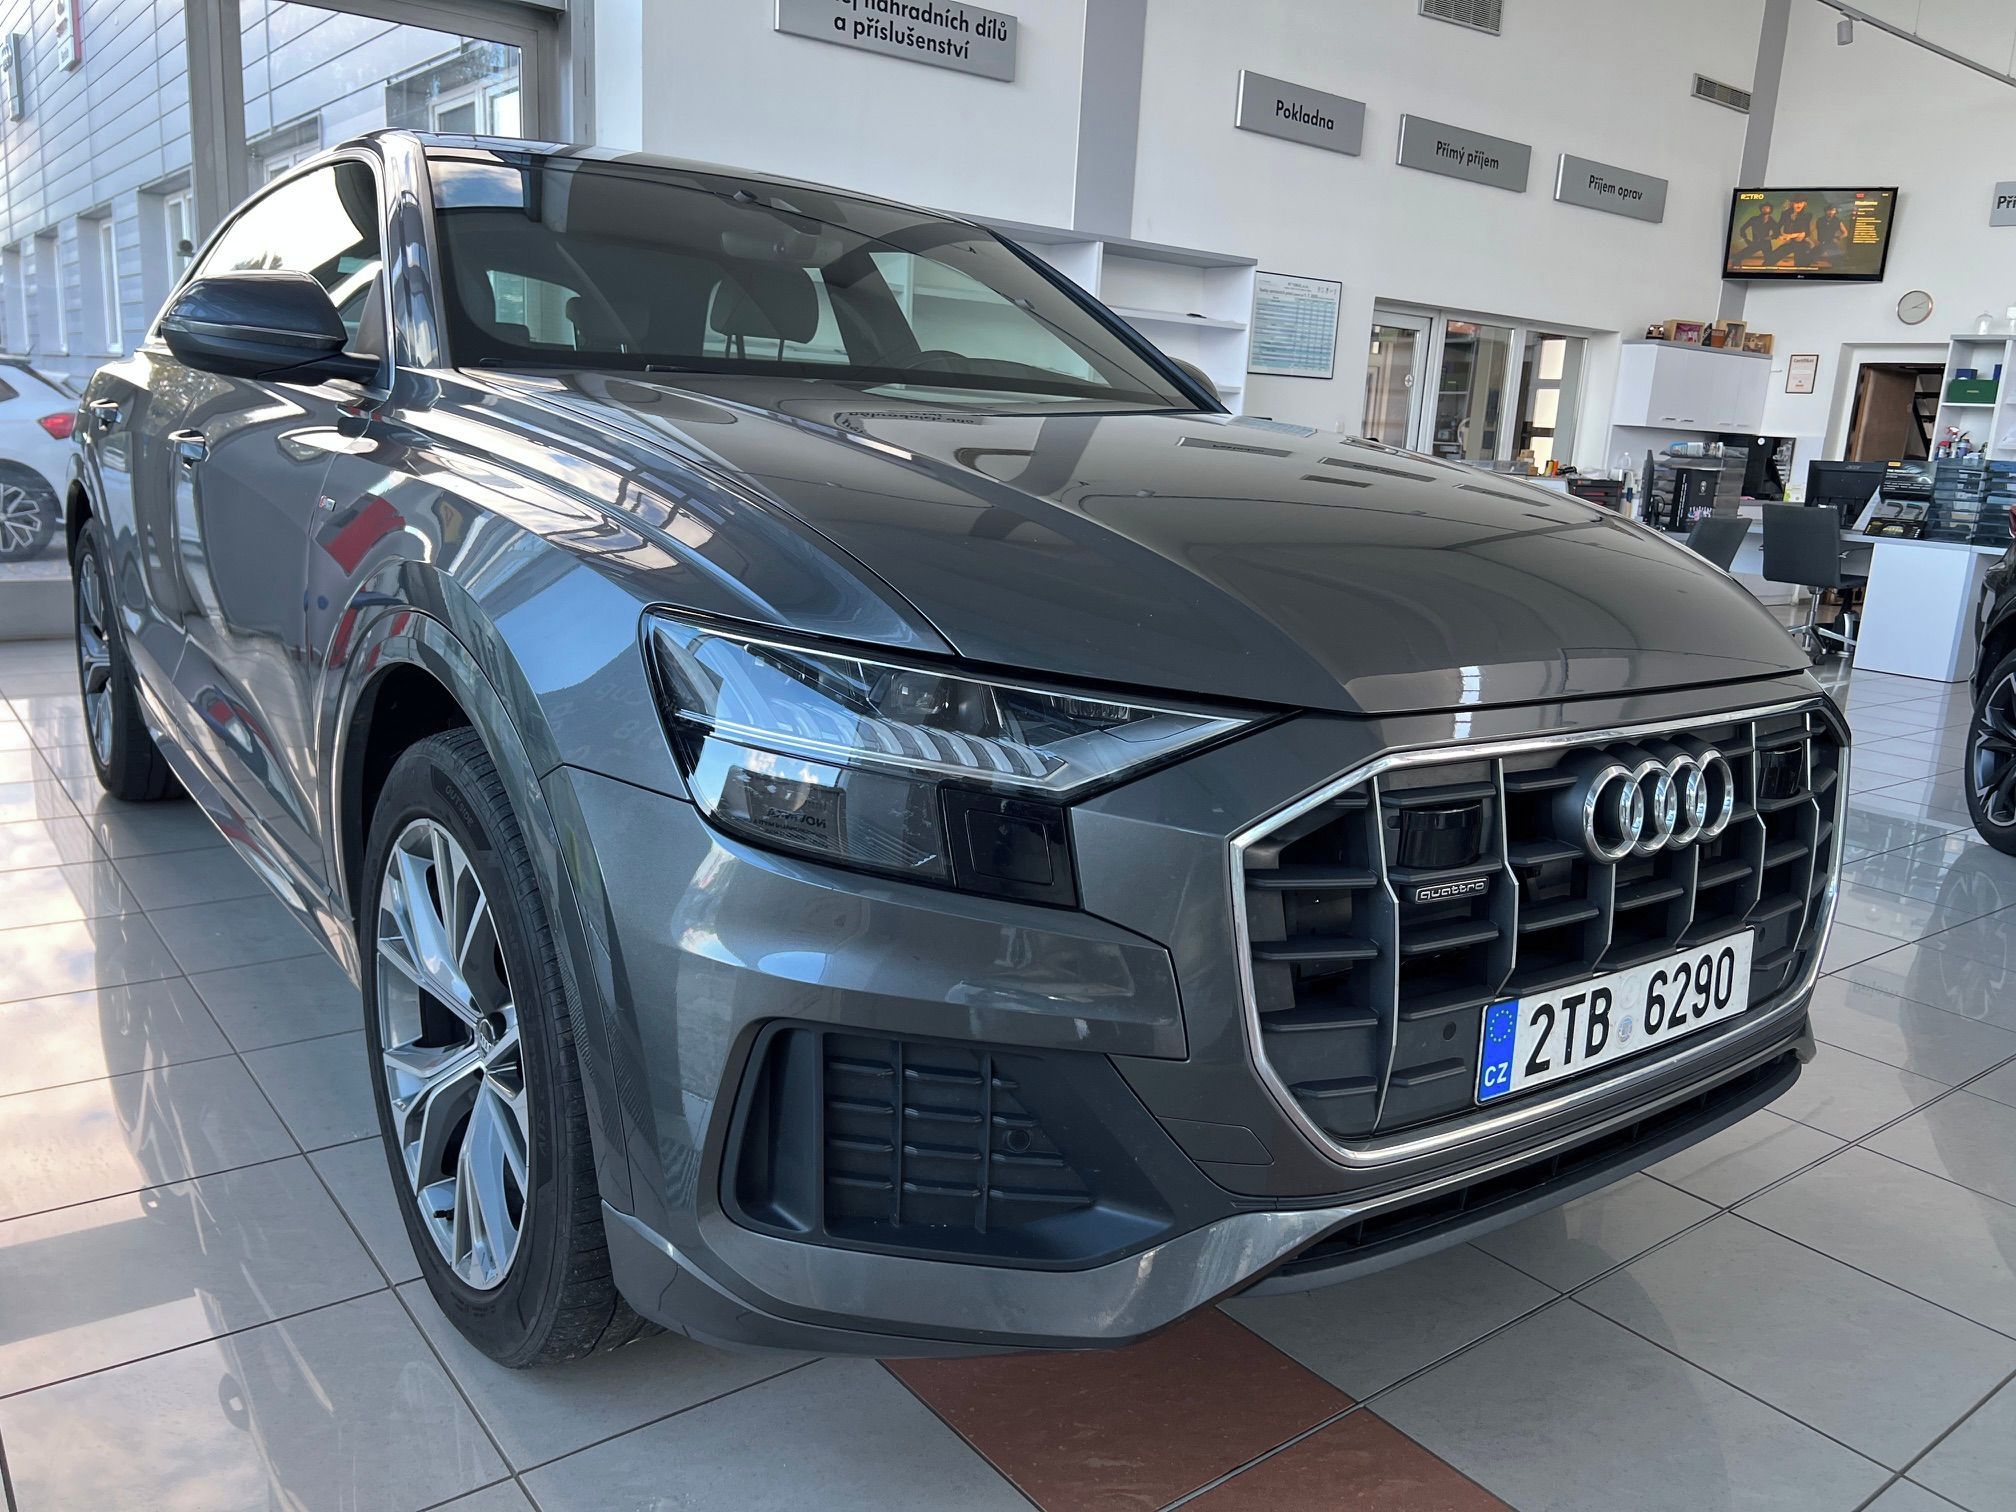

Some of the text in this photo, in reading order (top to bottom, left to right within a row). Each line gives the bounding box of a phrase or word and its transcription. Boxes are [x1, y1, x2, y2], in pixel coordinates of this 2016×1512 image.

[834, 16, 970, 59] a příslušenství
[975, 16, 1008, 41] dílů
[1275, 99, 1334, 130] Pokladna
[1435, 140, 1499, 170] Přímý příjem
[1588, 175, 1643, 201] Příjem oprav
[1420, 881, 1485, 900] quattro
[1524, 946, 1735, 1078] 2TB 6290
[1484, 1061, 1509, 1088] CZ
